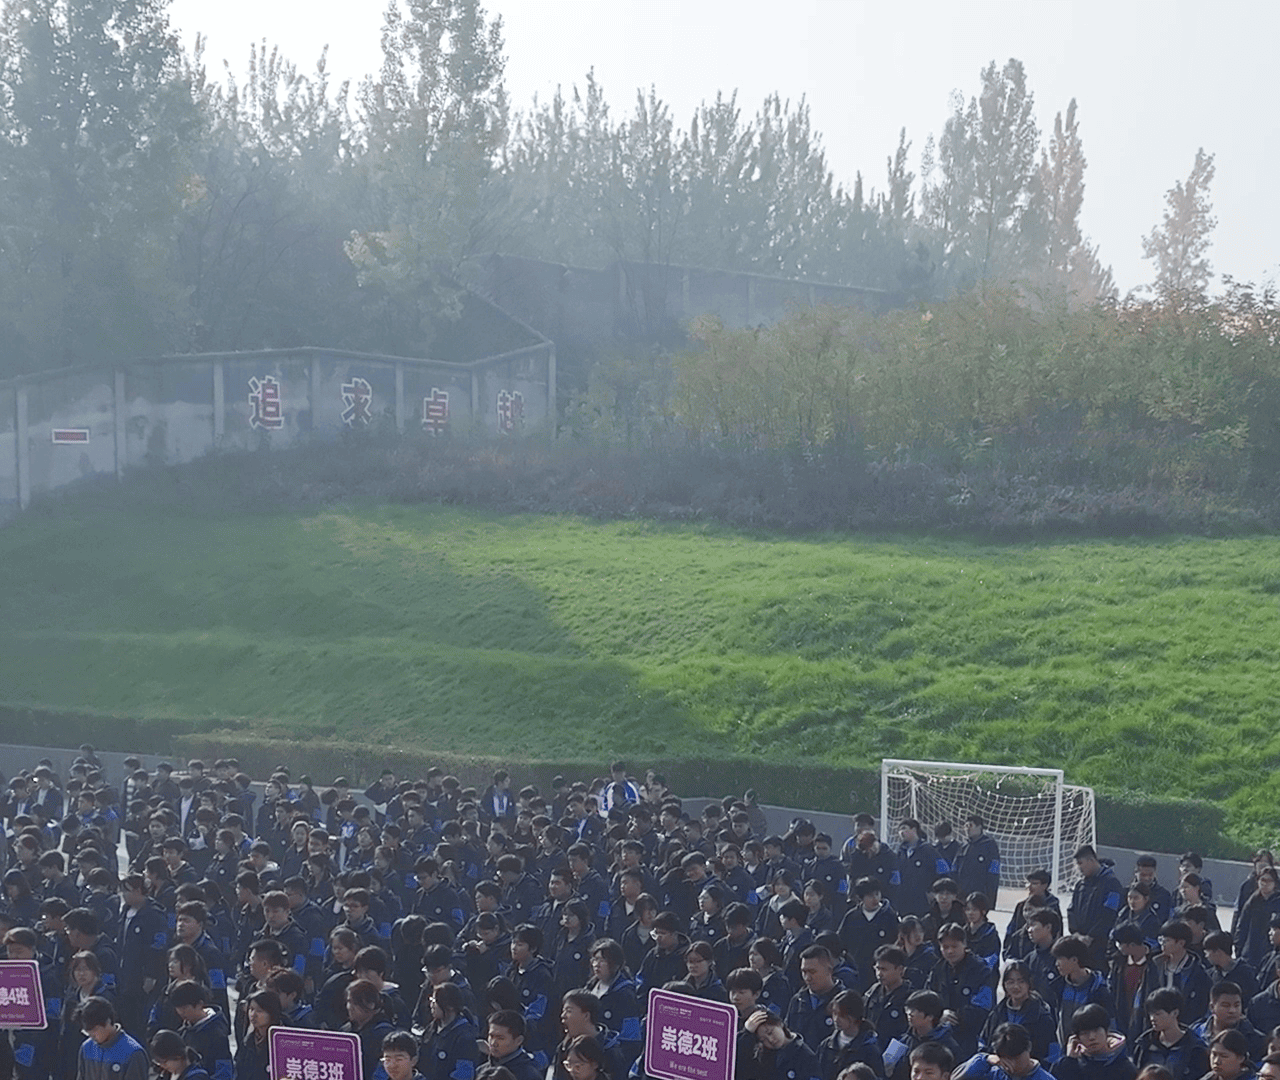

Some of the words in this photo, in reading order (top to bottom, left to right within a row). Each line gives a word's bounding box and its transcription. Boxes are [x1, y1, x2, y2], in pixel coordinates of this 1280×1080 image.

[248, 375, 524, 435] 追求卓越
[661, 1025, 718, 1062] 崇德2班
